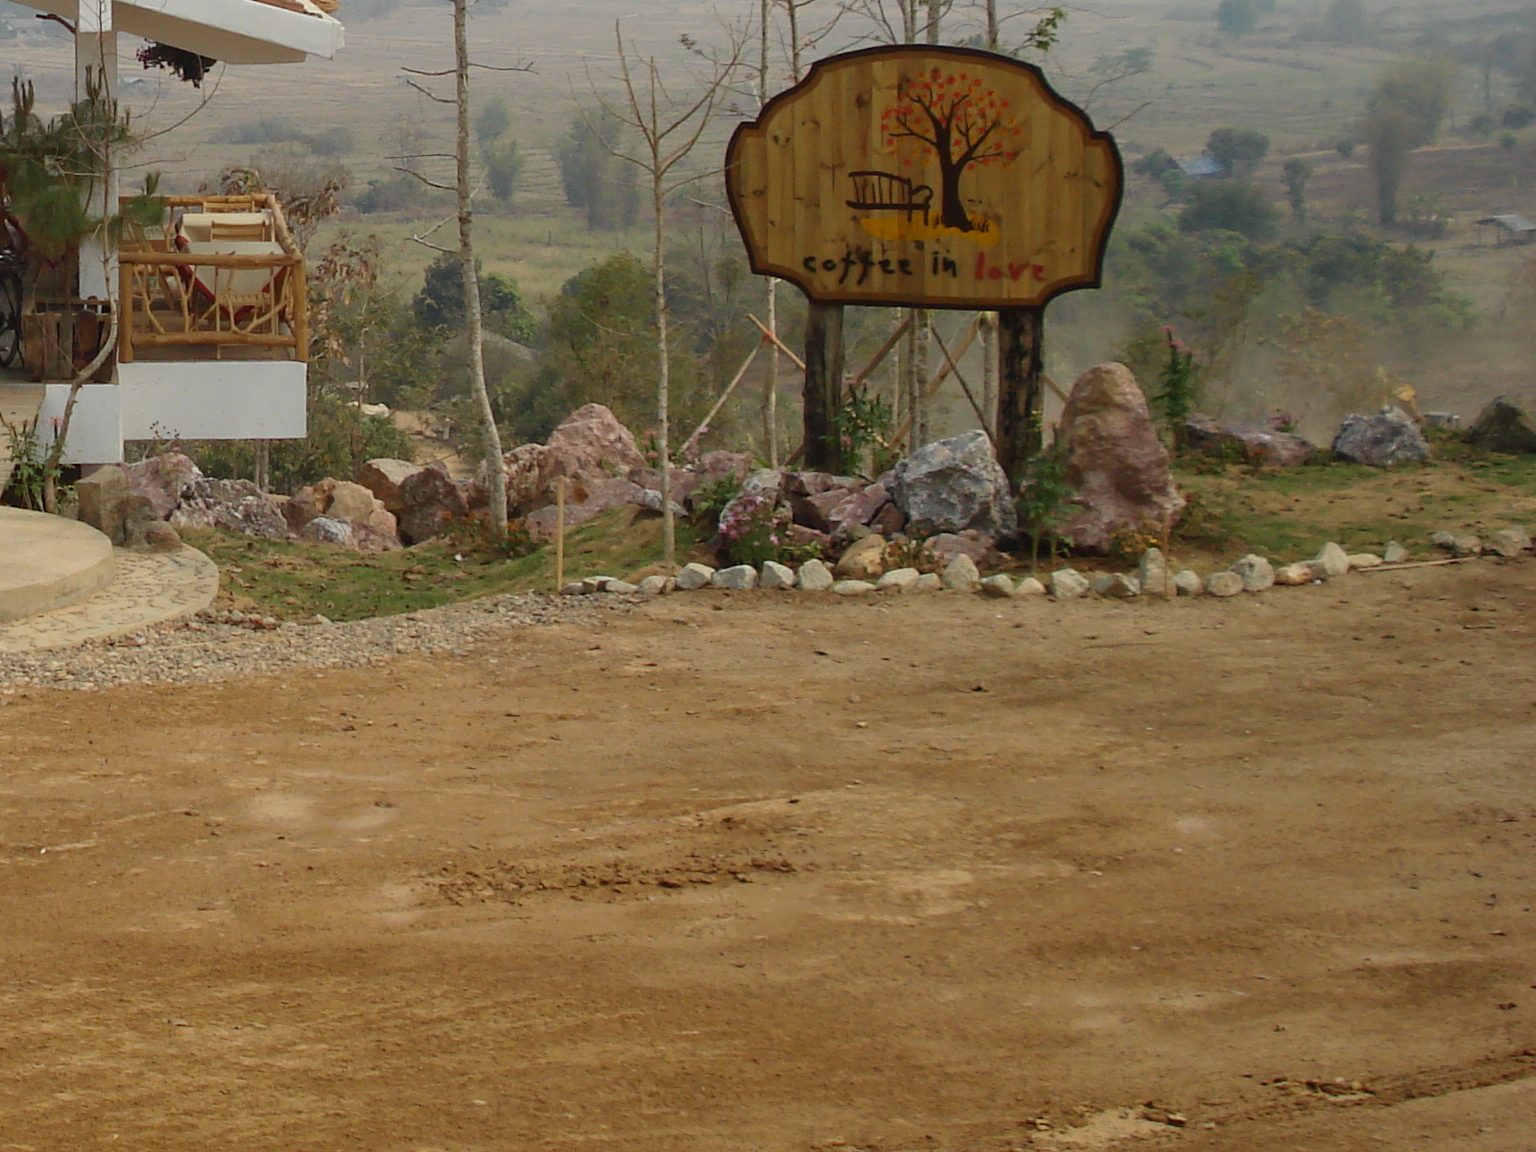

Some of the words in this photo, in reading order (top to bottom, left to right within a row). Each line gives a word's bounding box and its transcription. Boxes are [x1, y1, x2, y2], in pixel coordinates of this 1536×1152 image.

[803, 249, 912, 285] coffee
[932, 250, 957, 277] in
[975, 251, 1045, 281] love
